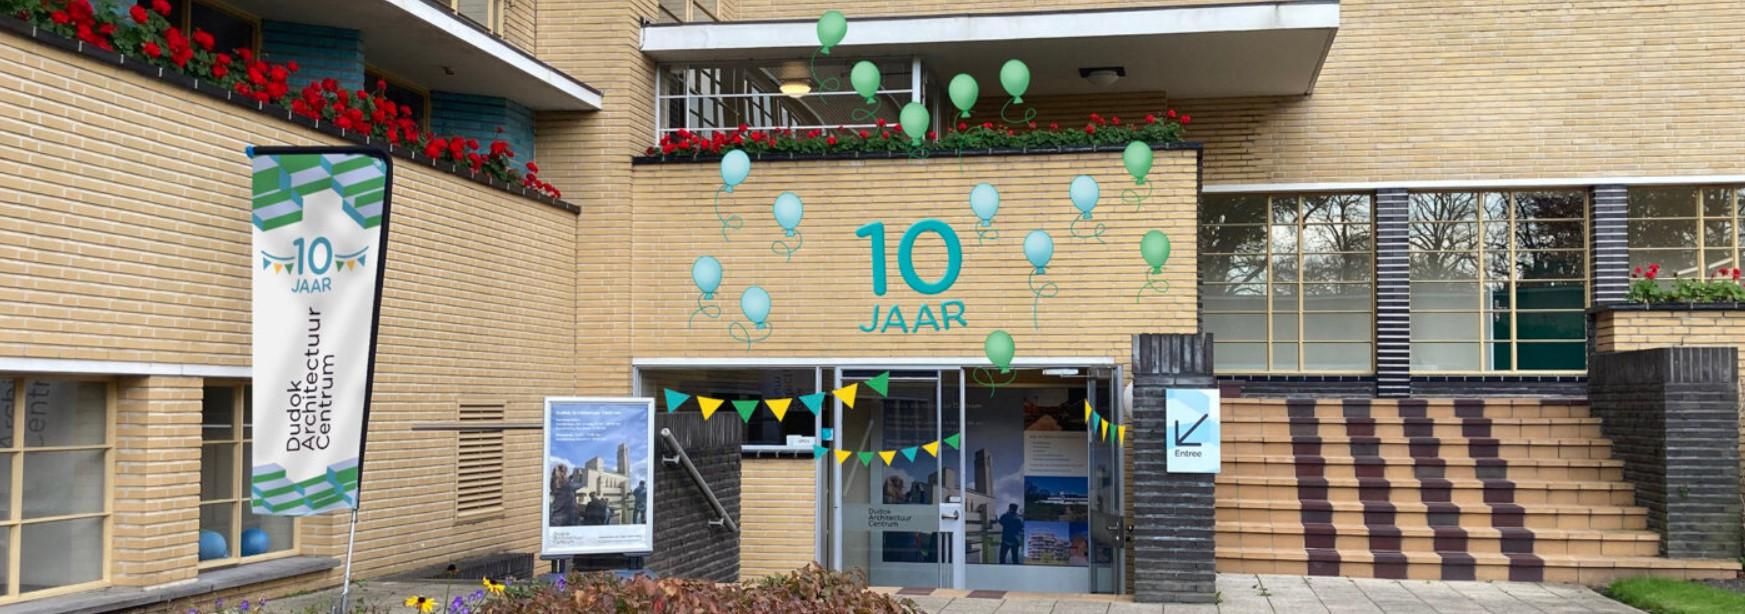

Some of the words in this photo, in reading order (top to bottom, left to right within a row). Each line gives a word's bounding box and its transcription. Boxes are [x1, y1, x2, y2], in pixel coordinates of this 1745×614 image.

[292, 236, 333, 276] 10
[291, 277, 332, 293] JAAR
[302, 306, 322, 451] Architectuur
[316, 353, 335, 450] Centrum
[286, 380, 302, 452] Dudok
[1175, 449, 1202, 458] Entree
